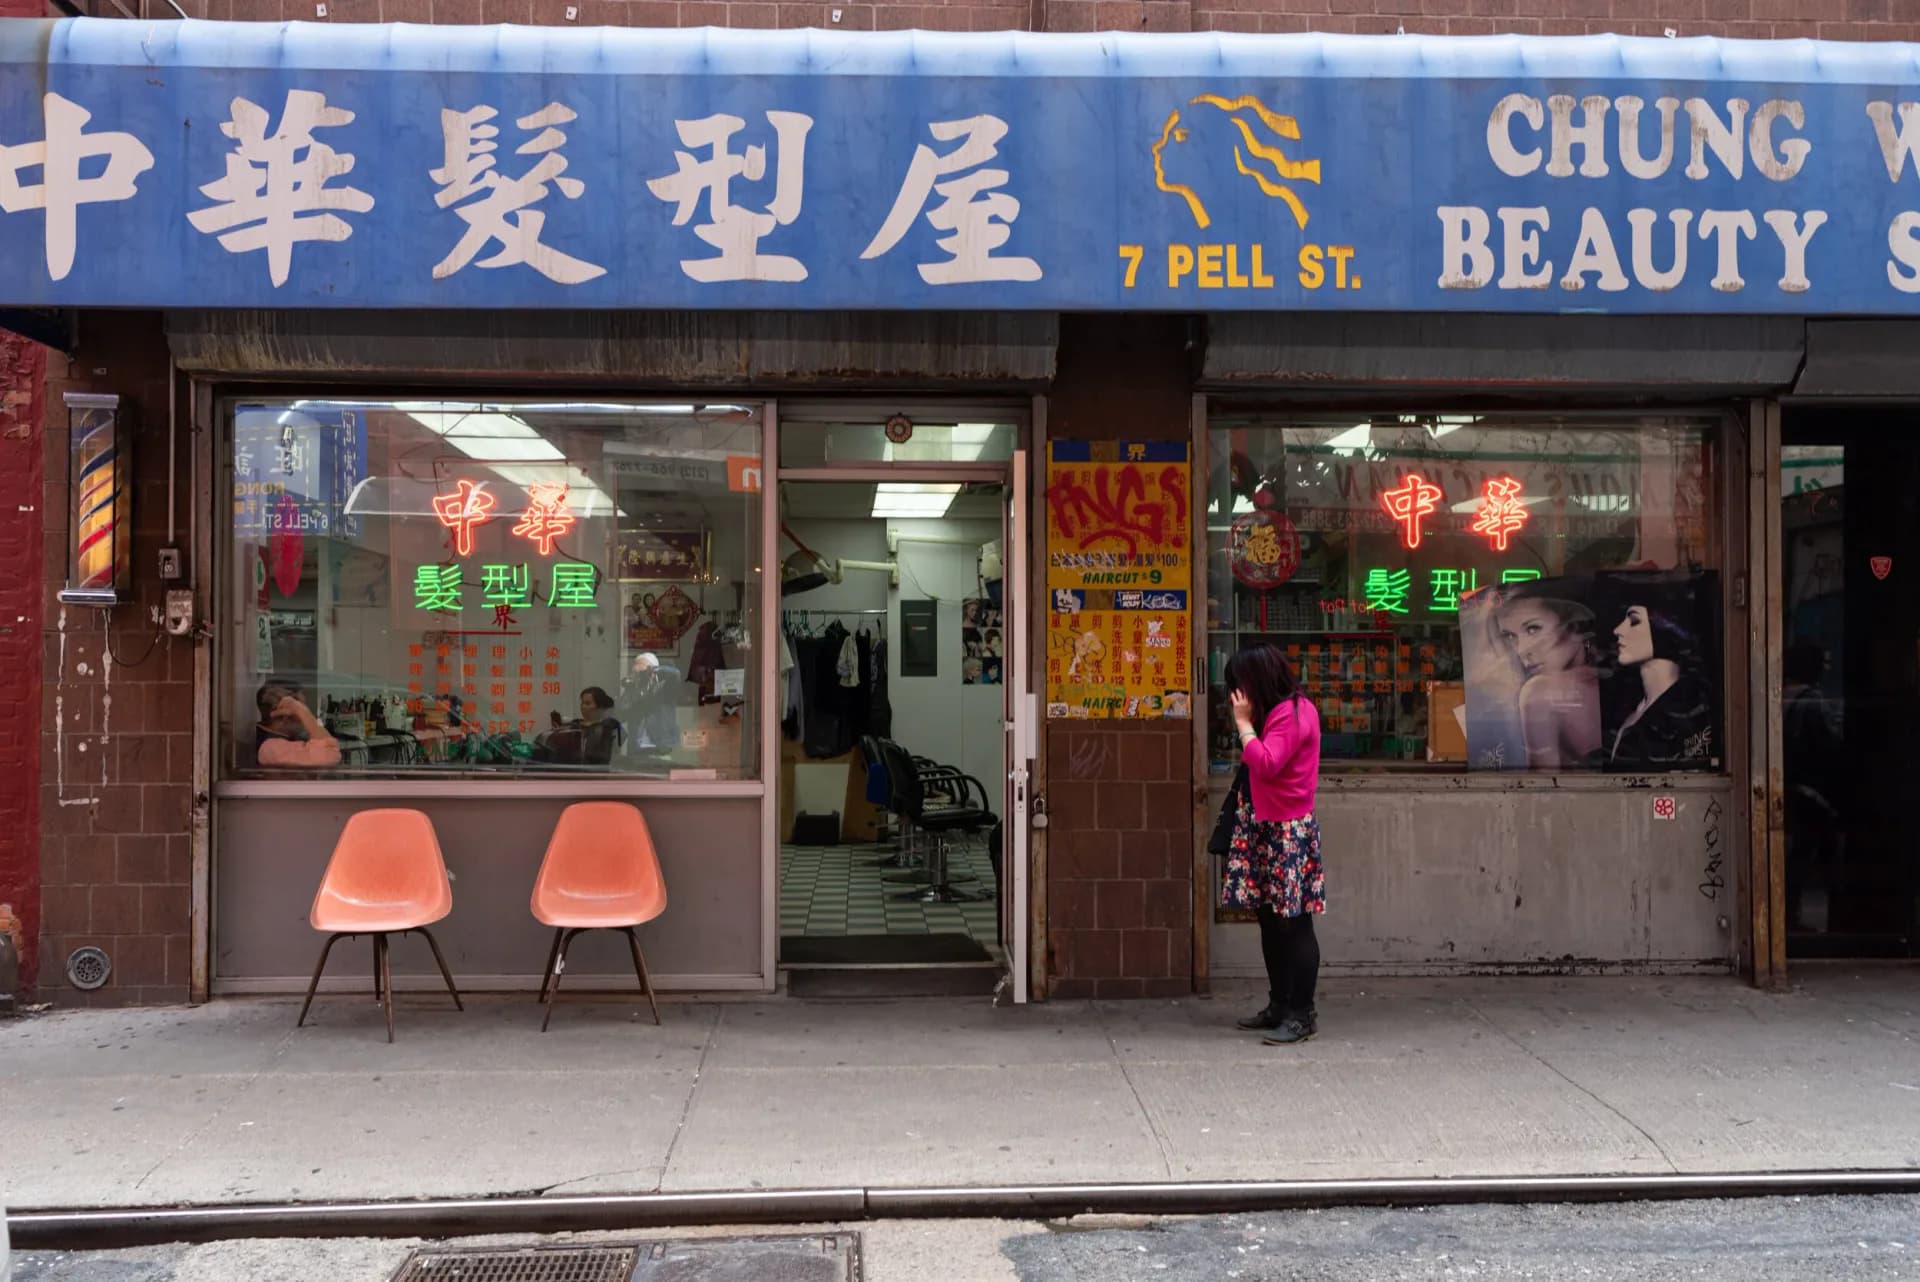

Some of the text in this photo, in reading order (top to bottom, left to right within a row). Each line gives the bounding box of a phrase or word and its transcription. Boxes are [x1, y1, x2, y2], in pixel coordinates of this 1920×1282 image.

[1486, 92, 1811, 182] CHUNG
[1118, 244, 1361, 289] 7 PELL ST.
[1437, 206, 1828, 293] BEAUTY
[433, 479, 575, 556] 中華
[1383, 474, 1529, 551] 中華
[414, 563, 598, 610] 髮型屋
[1082, 571, 1139, 585] HAIRCUT
